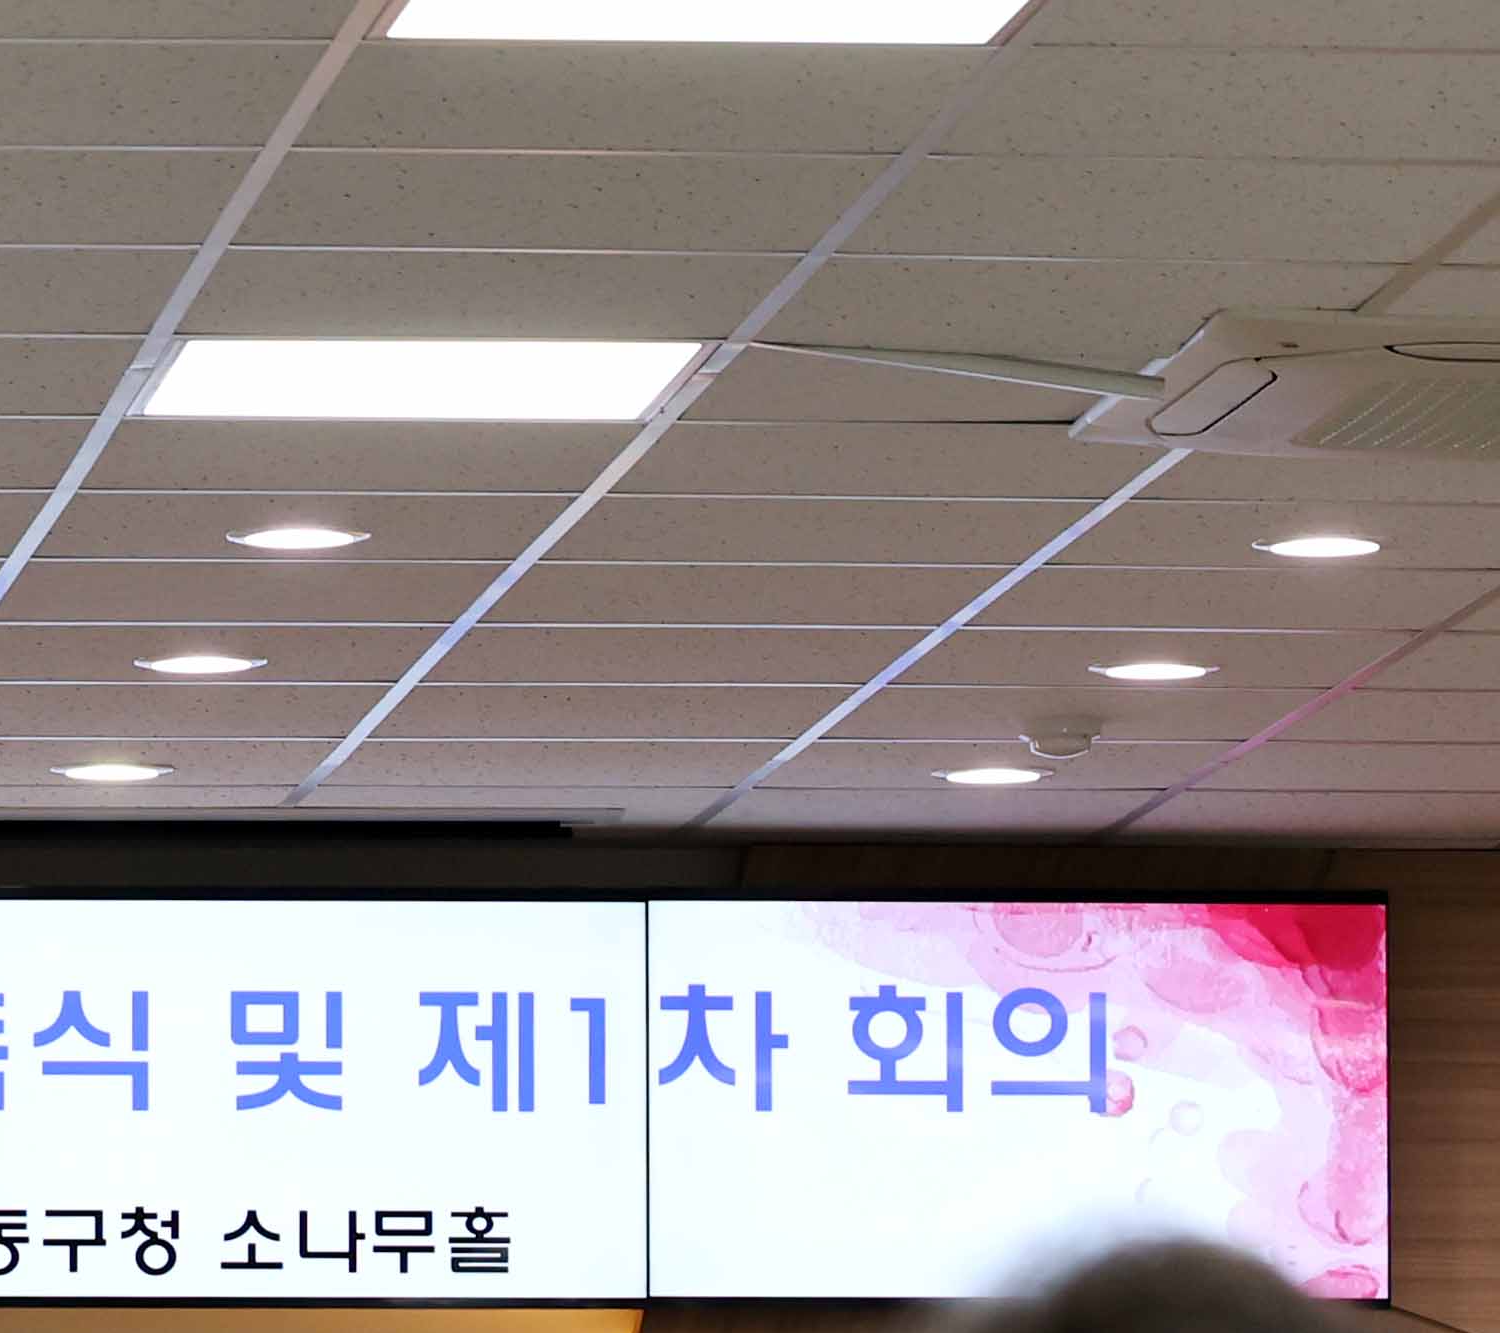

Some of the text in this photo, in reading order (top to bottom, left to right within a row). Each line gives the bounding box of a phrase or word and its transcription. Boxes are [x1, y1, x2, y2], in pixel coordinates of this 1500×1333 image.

[229, 989, 344, 1113] 및
[417, 984, 790, 1114] 제1차
[846, 984, 1114, 1116] 회의
[219, 1205, 512, 1275] 소나무홀
